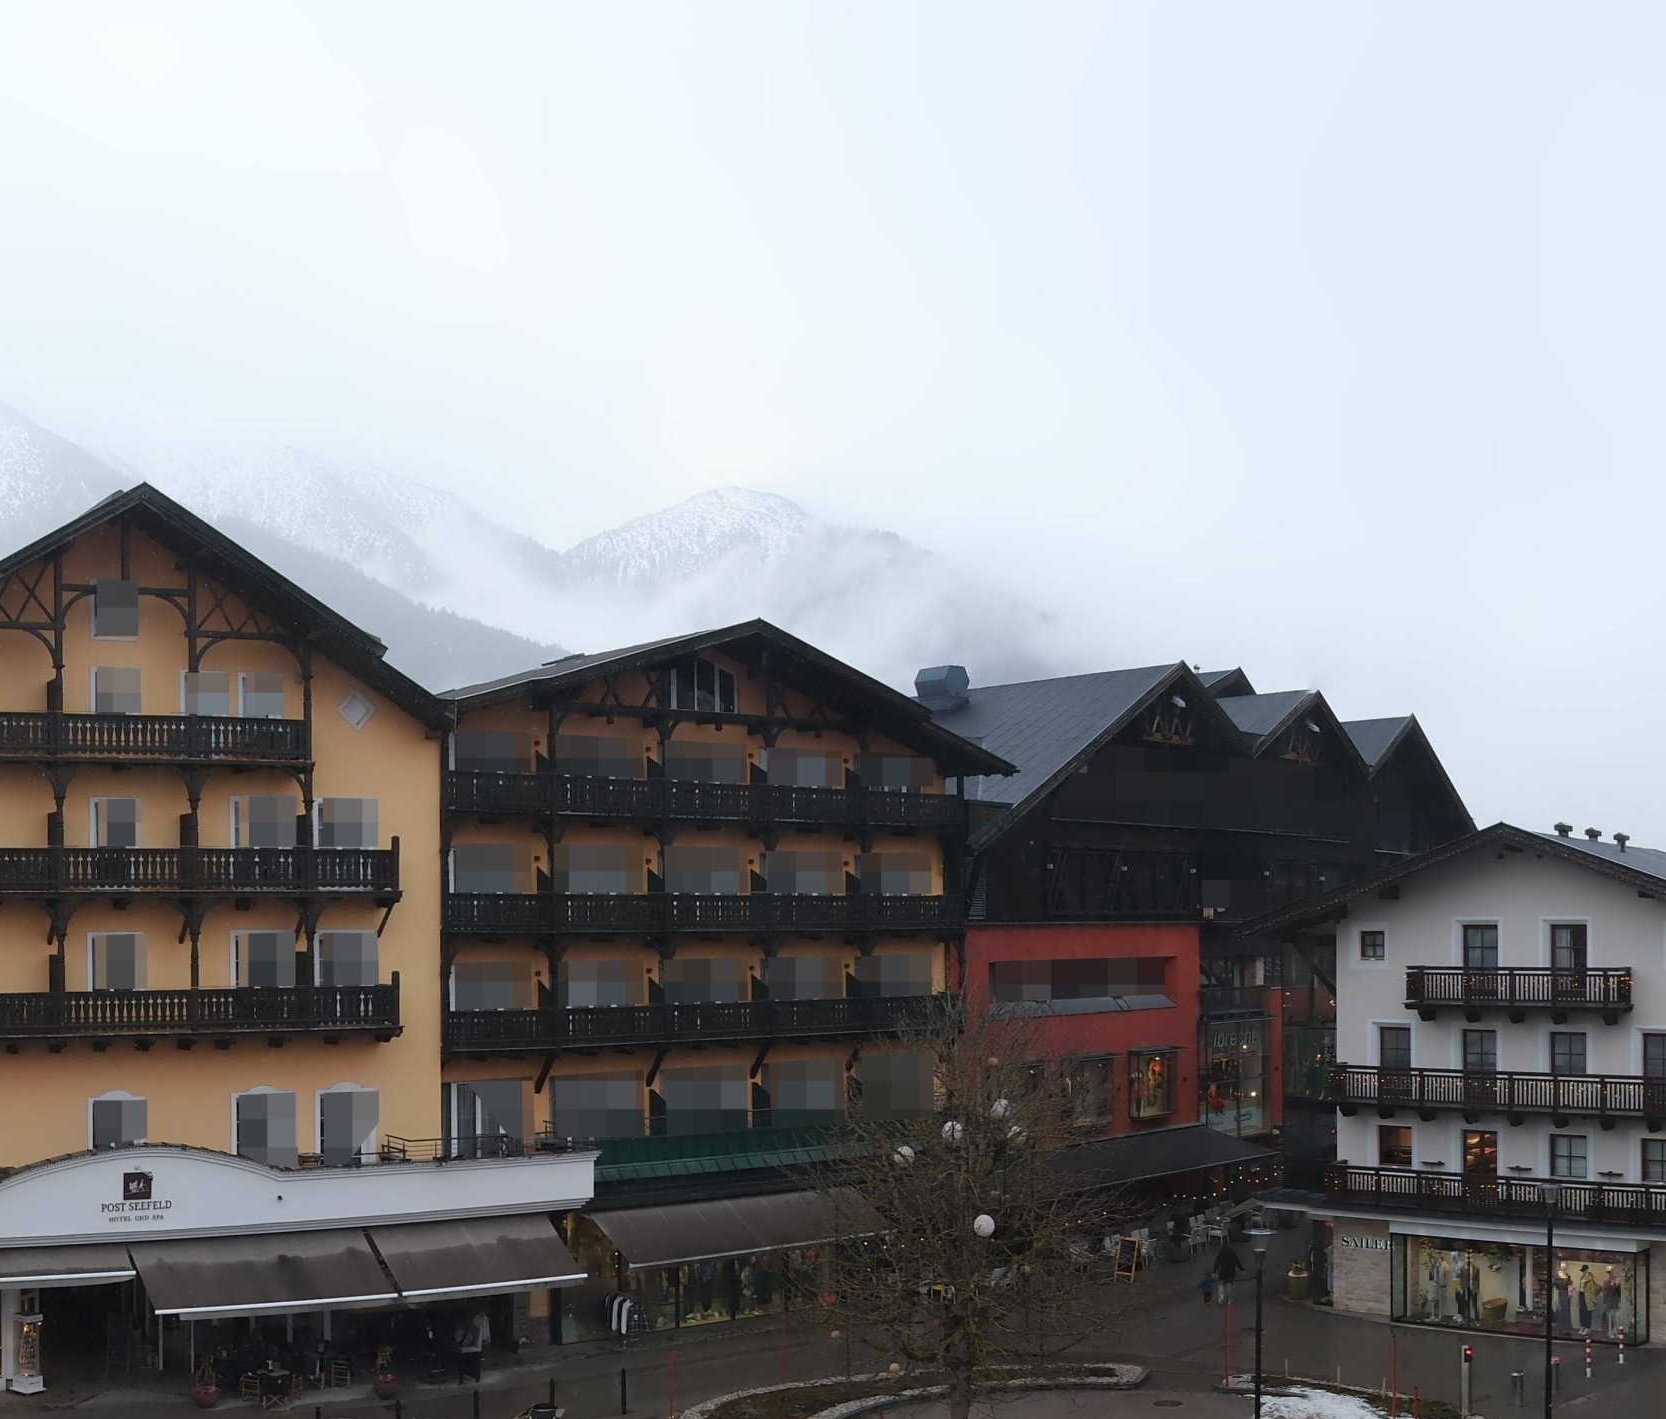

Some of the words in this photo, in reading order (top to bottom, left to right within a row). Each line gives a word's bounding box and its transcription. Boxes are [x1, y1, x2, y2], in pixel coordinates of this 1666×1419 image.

[101, 1202, 126, 1212] POST
[128, 1200, 172, 1211] SEEFELD
[109, 1215, 132, 1223] HOTEL
[1341, 1236, 1395, 1250] SAILER
